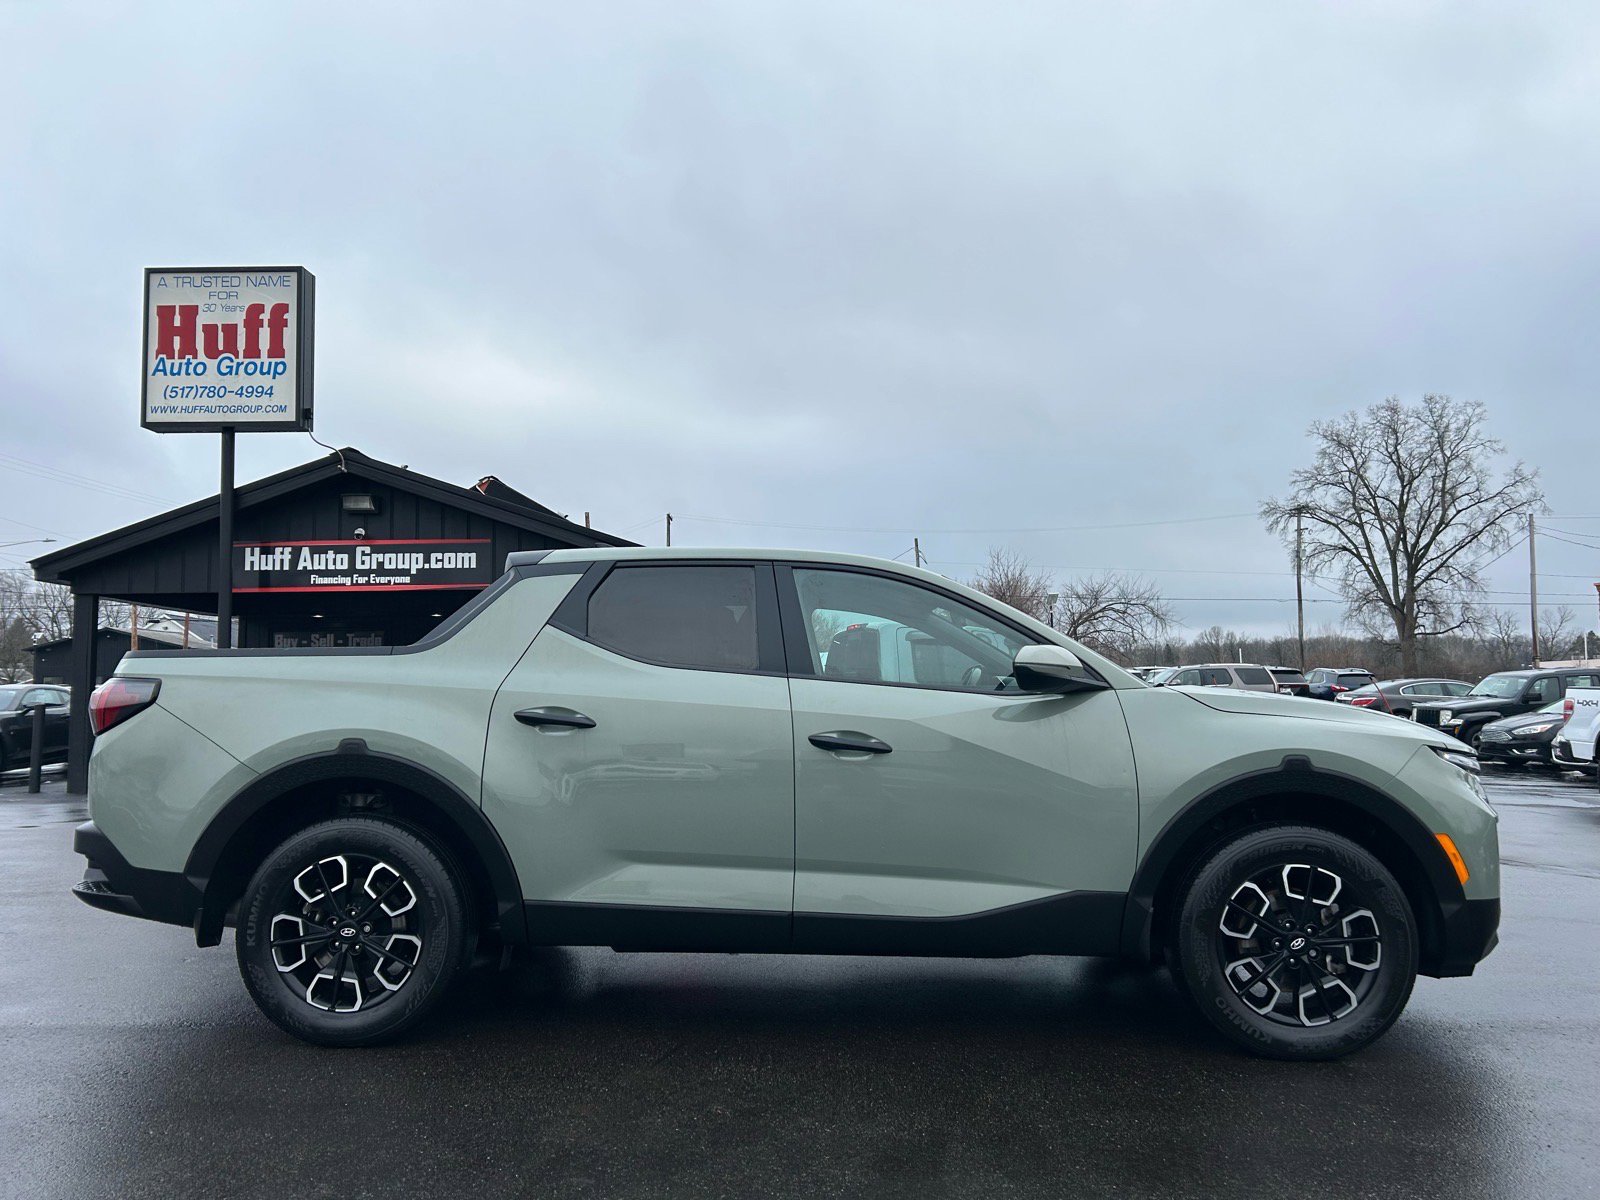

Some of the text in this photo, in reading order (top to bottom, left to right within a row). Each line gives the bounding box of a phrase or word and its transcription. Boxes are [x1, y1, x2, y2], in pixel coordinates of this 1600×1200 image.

[157, 275, 291, 288] A TRUSTED NAME
[208, 291, 239, 300] FOR
[202, 303, 245, 312] 30 Years
[155, 303, 289, 360] Huff
[151, 356, 287, 380] Auto Group
[163, 384, 274, 400] (517)780-4994
[150, 404, 287, 414] WWW.HUFFAUTOGROUP.COM
[244, 546, 477, 574] Huff Auto Group.com
[310, 573, 411, 586] Financing For Everyone
[274, 634, 298, 648] Buy
[310, 633, 335, 647] Sell
[345, 633, 382, 647] Trade
[246, 883, 269, 947] KUMHO
[1216, 996, 1273, 1045] KUMHO
